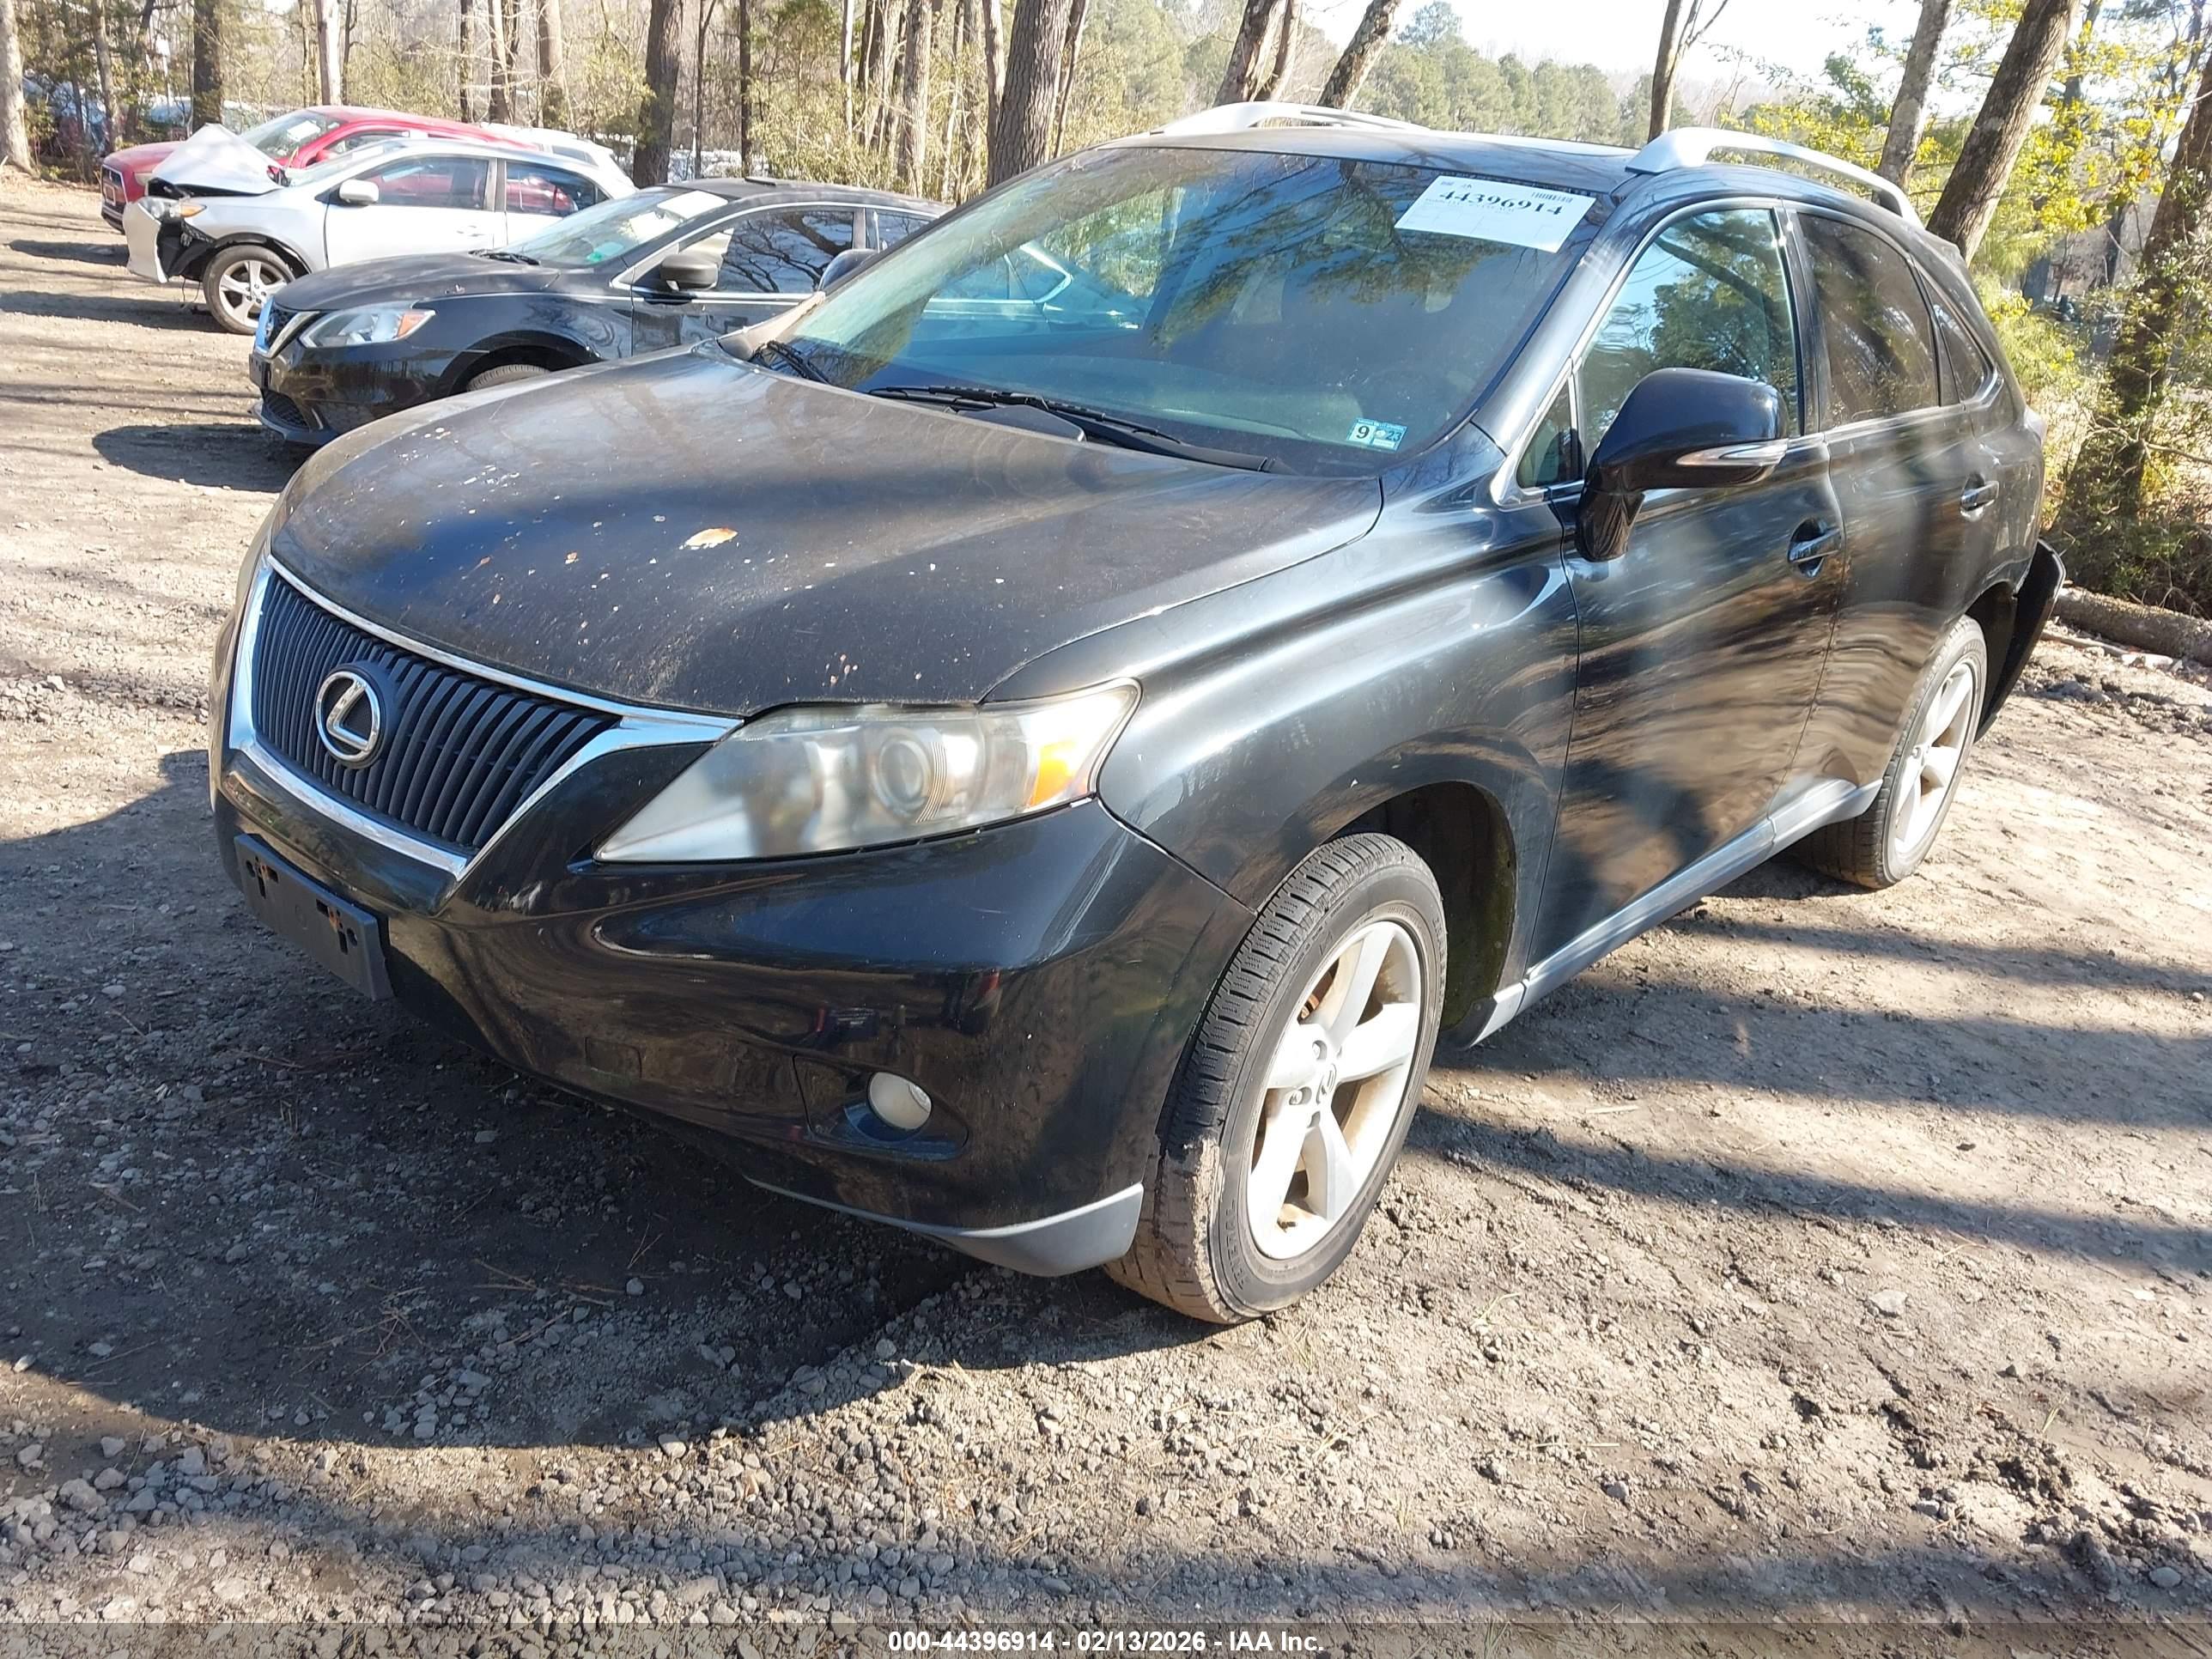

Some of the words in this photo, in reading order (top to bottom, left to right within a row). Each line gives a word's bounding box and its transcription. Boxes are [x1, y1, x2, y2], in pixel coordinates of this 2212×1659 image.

[1440, 191, 1563, 216] 44396914
[1357, 426, 1370, 439] 9
[1386, 430, 1402, 441] 23
